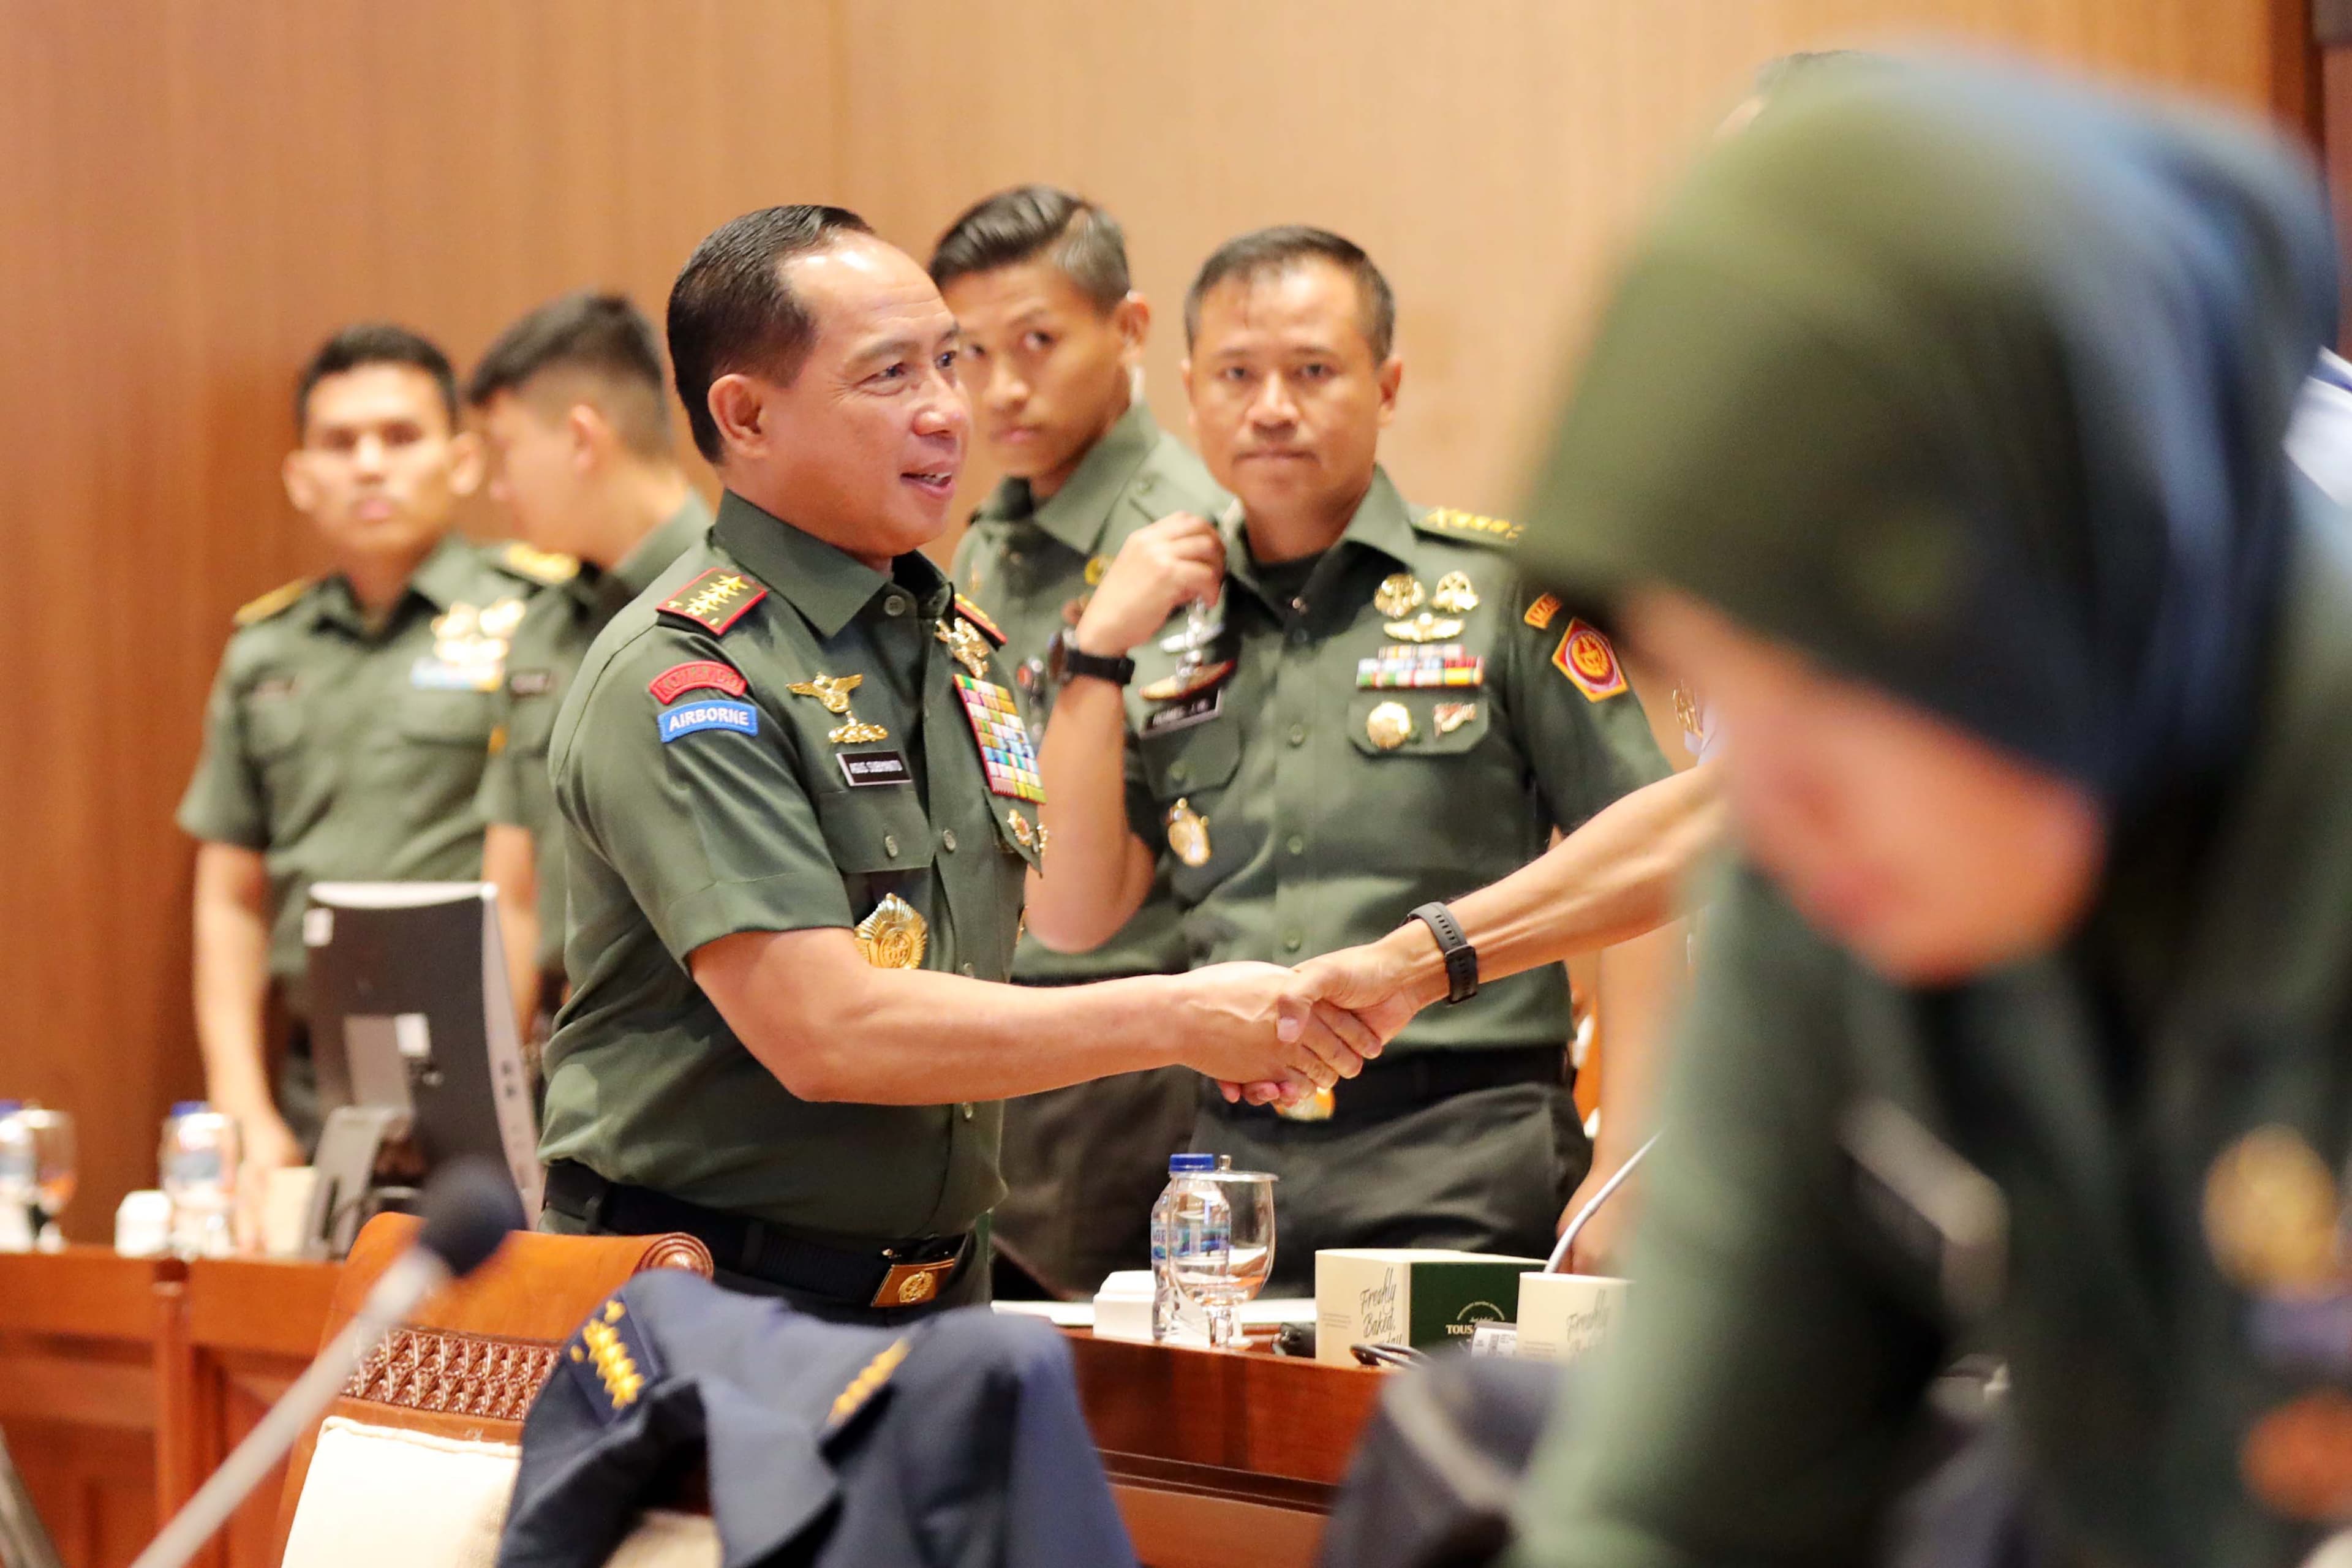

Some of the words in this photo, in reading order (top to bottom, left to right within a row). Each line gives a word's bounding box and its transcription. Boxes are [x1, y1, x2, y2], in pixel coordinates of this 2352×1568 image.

[669, 707, 749, 732] AIRBORNE
[1360, 1267, 1396, 1314] Freshly
[1446, 1325, 1473, 1335] TOUS
